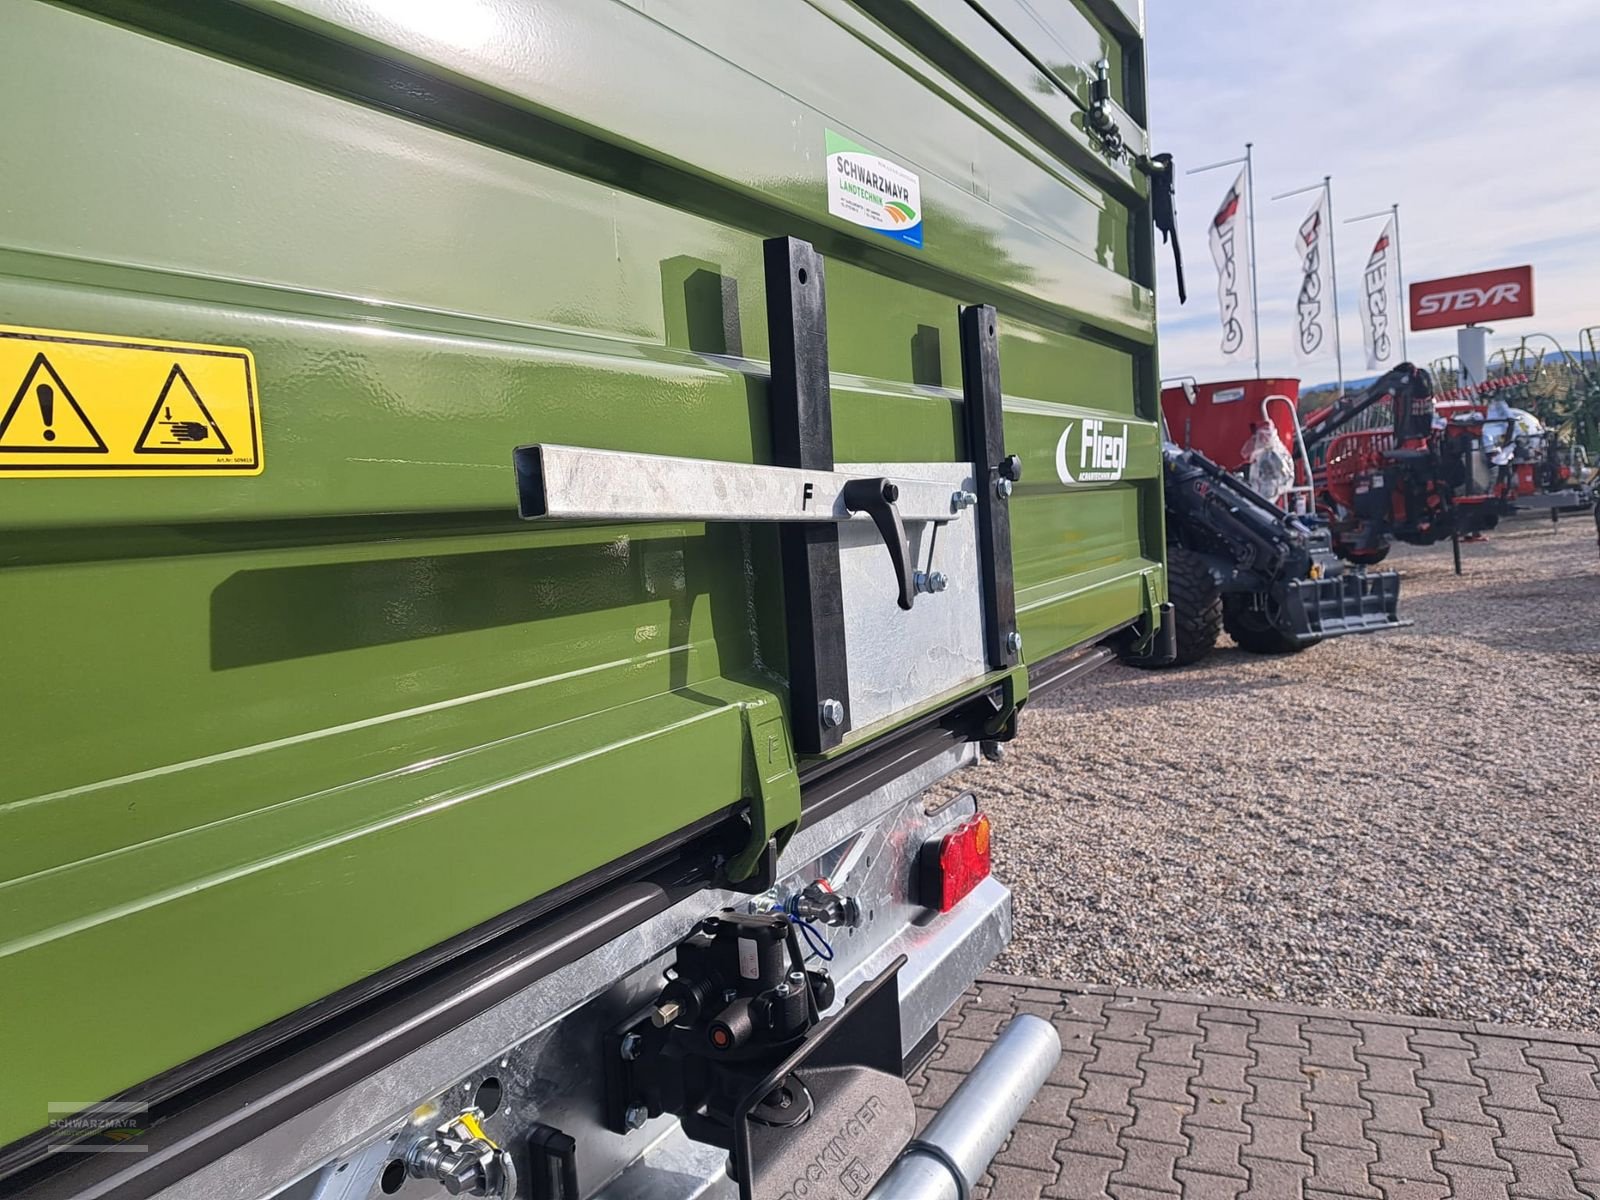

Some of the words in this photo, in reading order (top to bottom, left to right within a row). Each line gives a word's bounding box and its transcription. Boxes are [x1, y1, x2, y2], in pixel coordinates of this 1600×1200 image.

[837, 156, 909, 202] SCHWARZMAYR
[839, 177, 885, 207] LANDTECHNIK
[1417, 283, 1521, 316] STEYR
[1080, 419, 1128, 478] Fliegl
[802, 482, 813, 511] F
